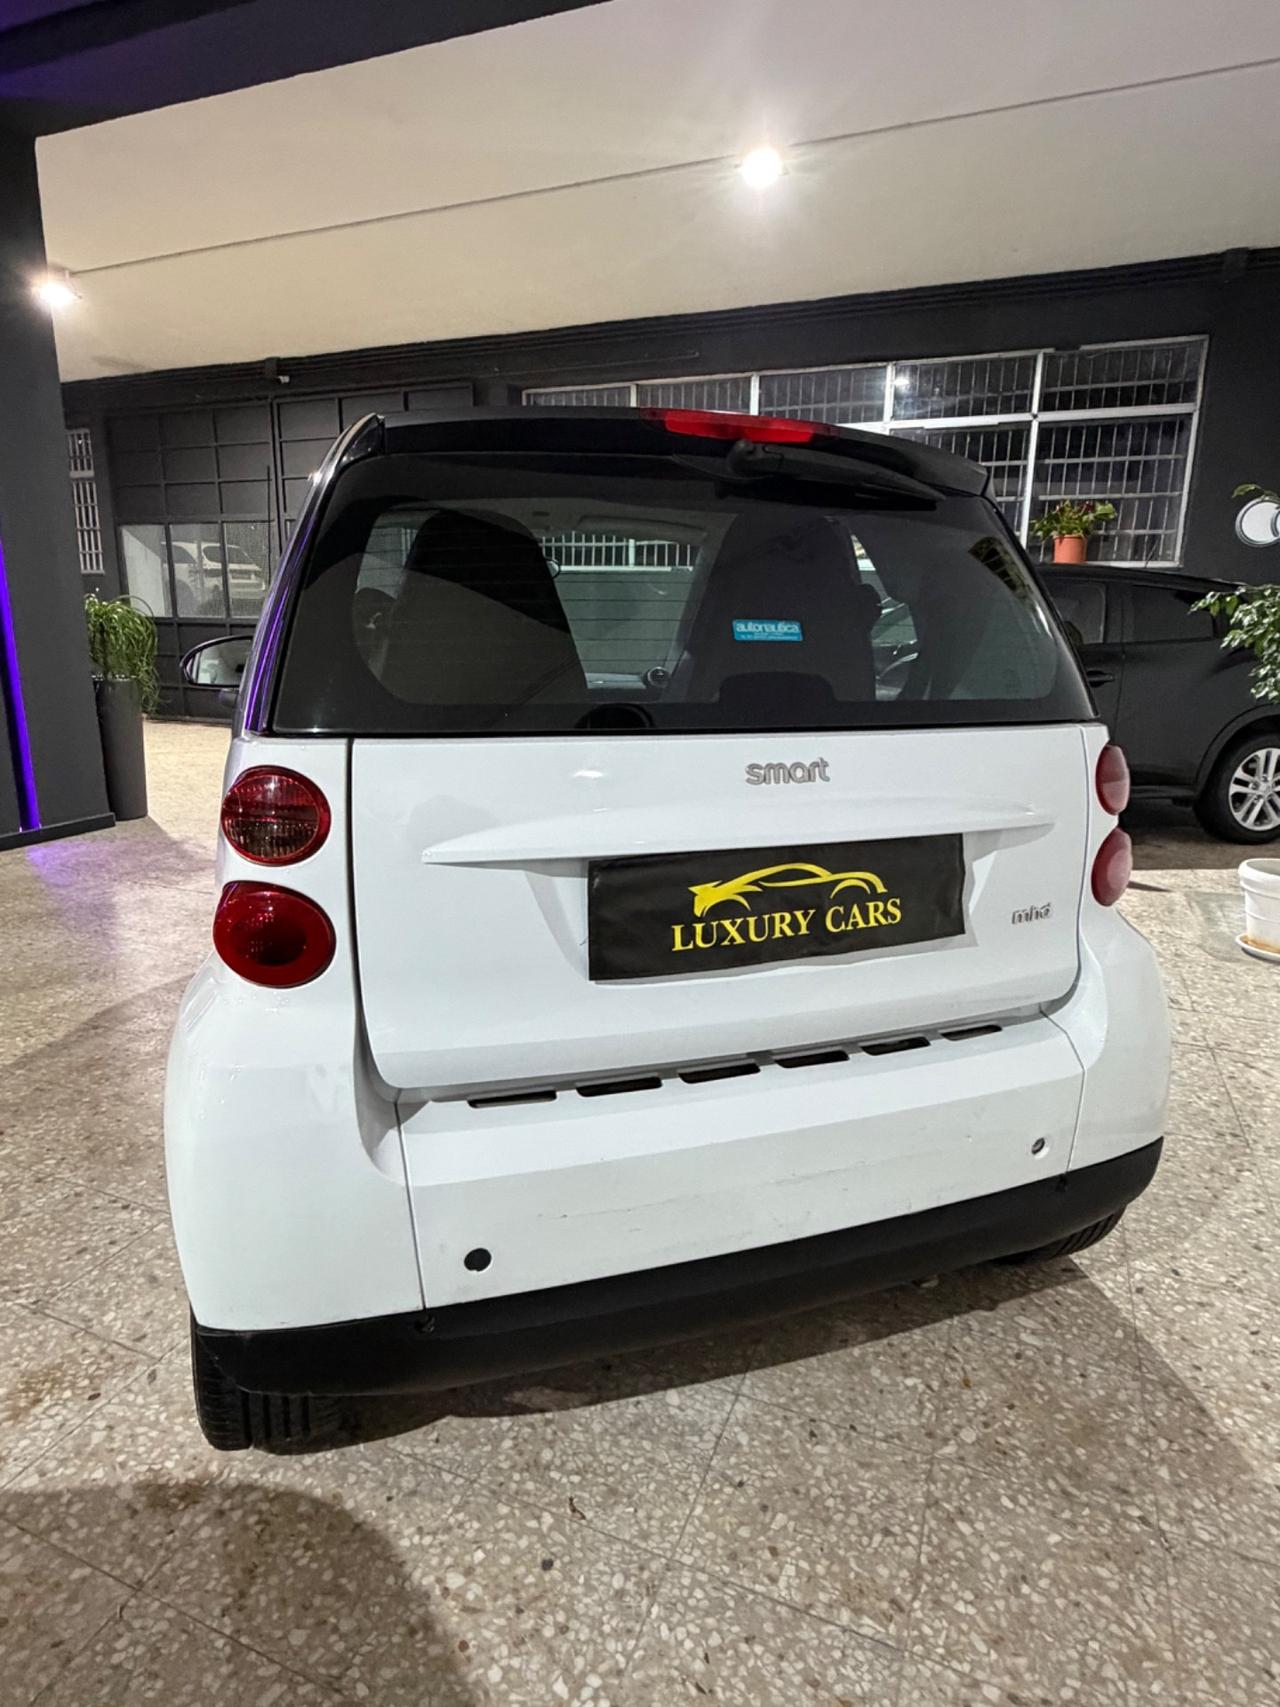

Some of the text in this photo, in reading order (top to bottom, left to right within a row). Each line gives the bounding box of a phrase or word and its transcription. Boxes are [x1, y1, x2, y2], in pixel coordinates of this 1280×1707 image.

[745, 757, 831, 785] smart
[672, 898, 902, 951] LUXURY CARS
